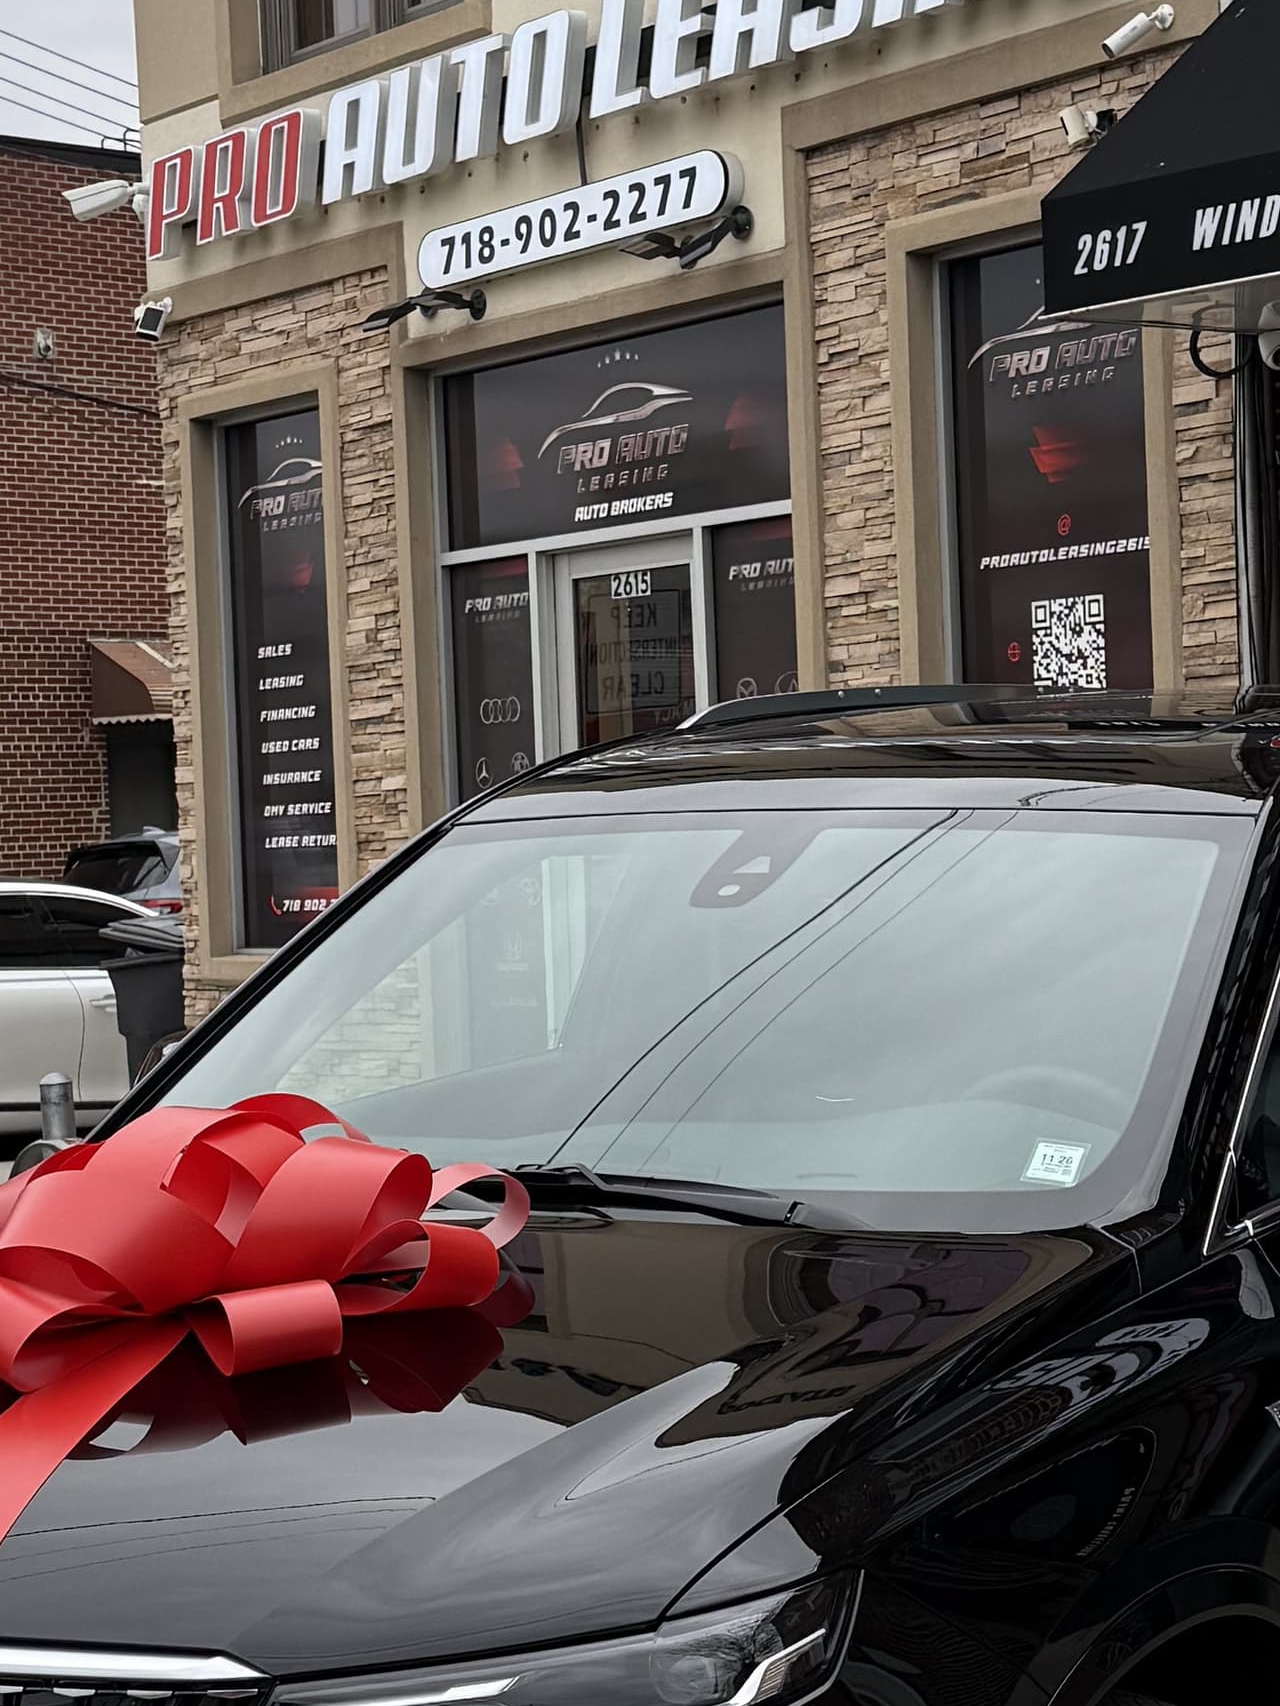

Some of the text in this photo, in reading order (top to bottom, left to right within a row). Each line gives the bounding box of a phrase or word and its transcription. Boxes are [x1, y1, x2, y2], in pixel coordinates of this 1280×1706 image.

[147, 108, 318, 261] PRO
[321, 8, 588, 205] AUTO
[439, 169, 698, 275] 718-902-2277
[1074, 221, 1147, 276] 2617
[989, 329, 1138, 382] PRO AUTO
[1011, 366, 1117, 398] LEASING
[557, 424, 689, 474] PRO AUTO
[577, 464, 669, 493] LEASING
[250, 488, 322, 520] PRO AUT
[575, 492, 673, 522] AUTO BROKERS
[729, 558, 794, 581] PRO AUT
[613, 572, 649, 597] 2615
[465, 592, 528, 614] PRO AUTO
[258, 643, 292, 659] SALES
[259, 674, 304, 690] LEASING
[260, 705, 316, 722] FINANCING
[262, 737, 320, 753] USED CARS
[263, 770, 322, 785] INSURANCE
[287, 802, 332, 816] SERVICE
[265, 834, 338, 849] LEASE RETUR
